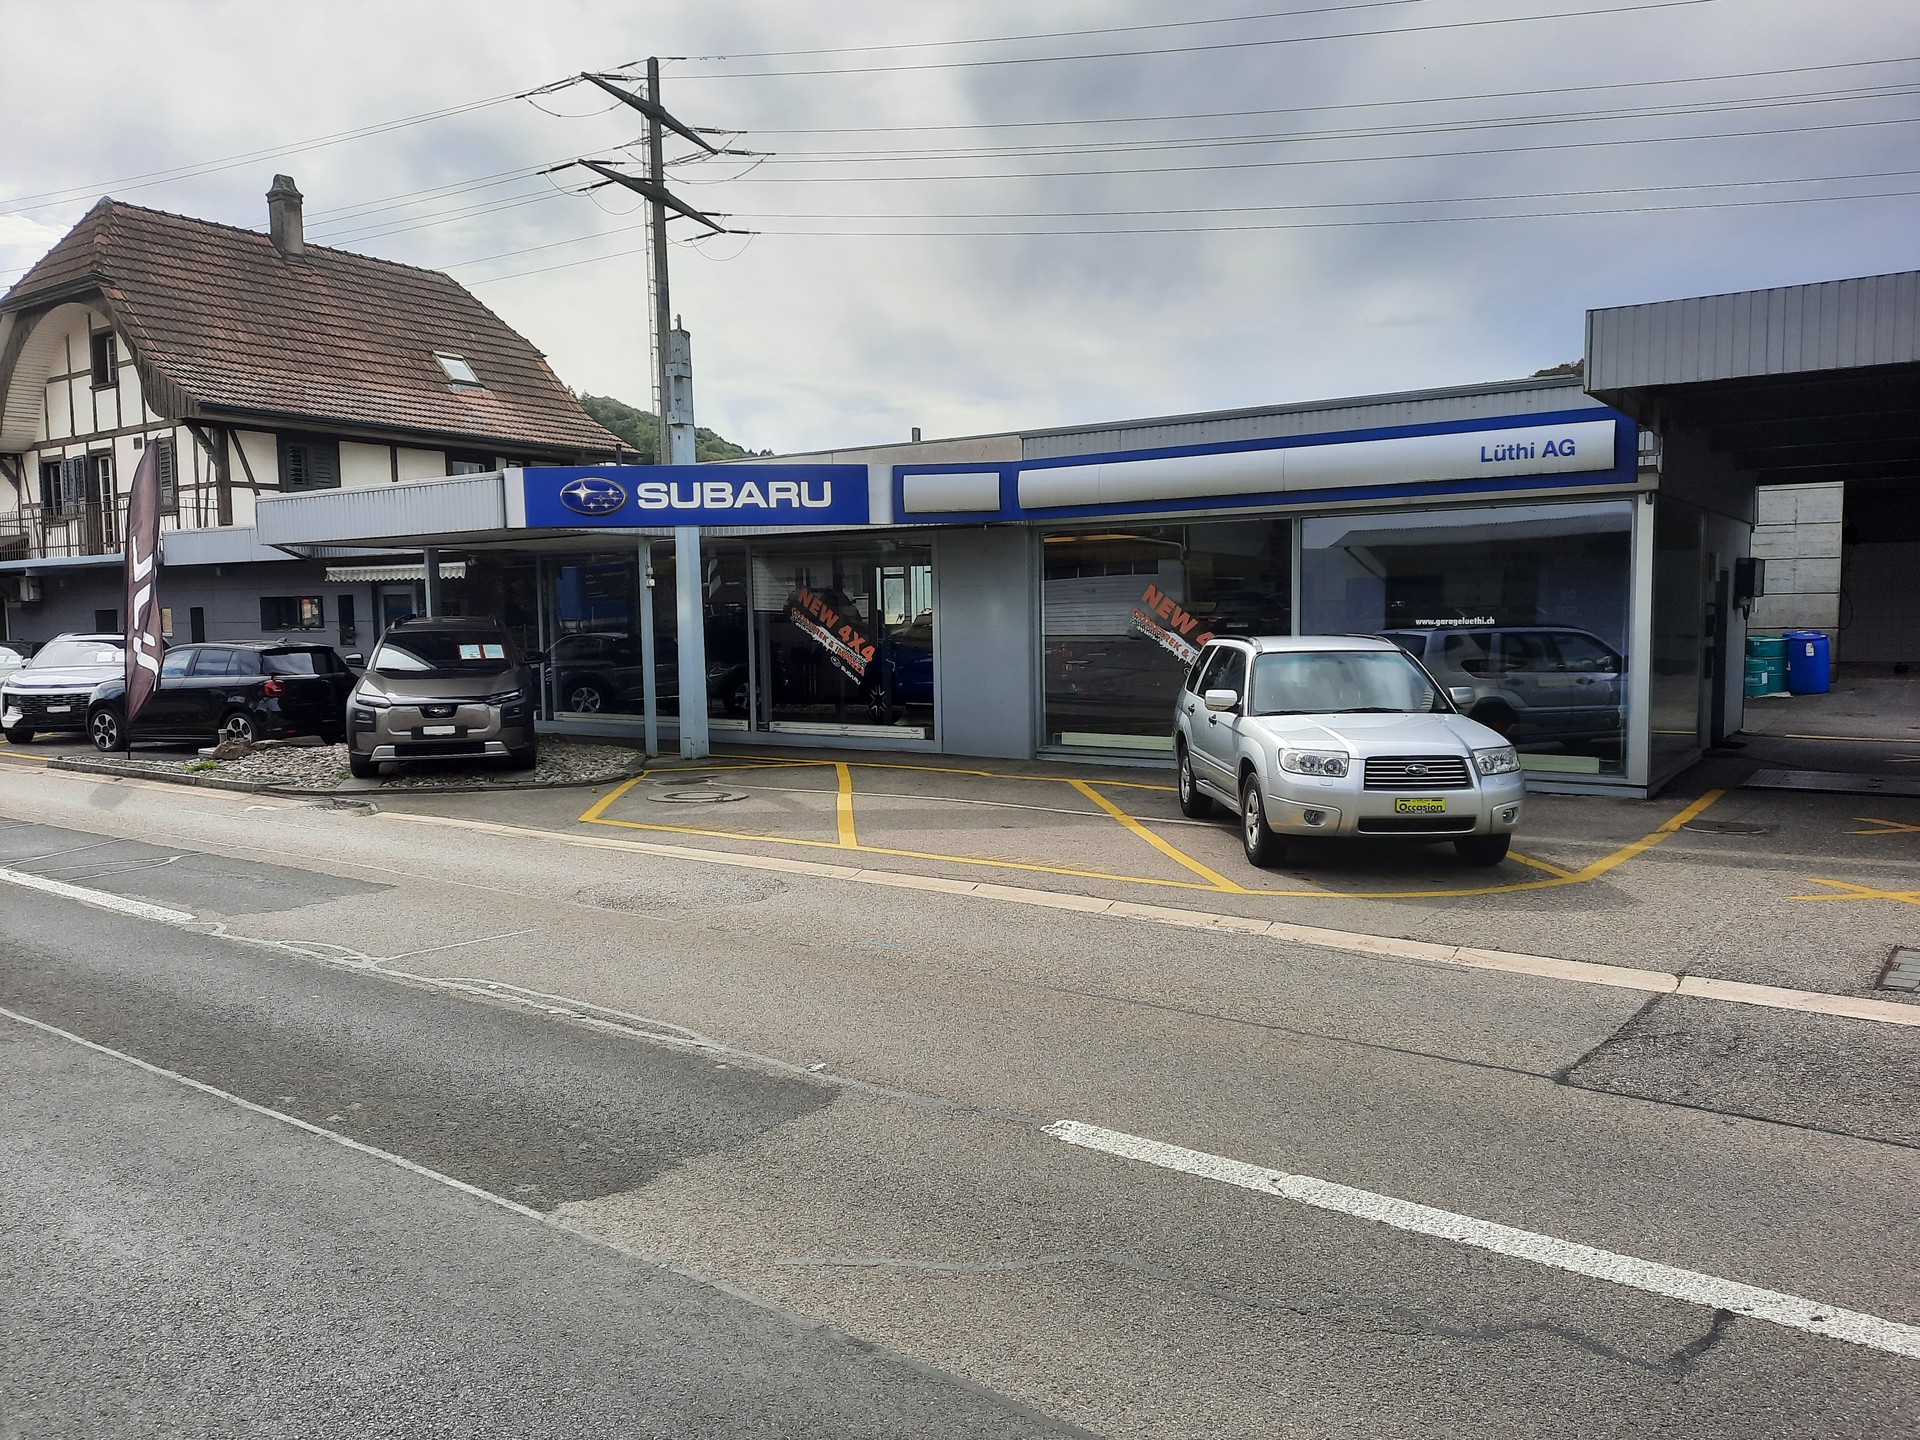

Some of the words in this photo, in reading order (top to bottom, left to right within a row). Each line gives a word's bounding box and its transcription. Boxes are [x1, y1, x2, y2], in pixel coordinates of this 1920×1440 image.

[1481, 442, 1535, 462] Lüthi
[1541, 439, 1576, 458] AG
[637, 481, 831, 509] SUBARU
[1142, 583, 1198, 635] NEW
[798, 587, 839, 629] NEW
[838, 625, 876, 662] 4X4
[1181, 648, 1190, 658] &
[1399, 802, 1443, 811] Occasion
